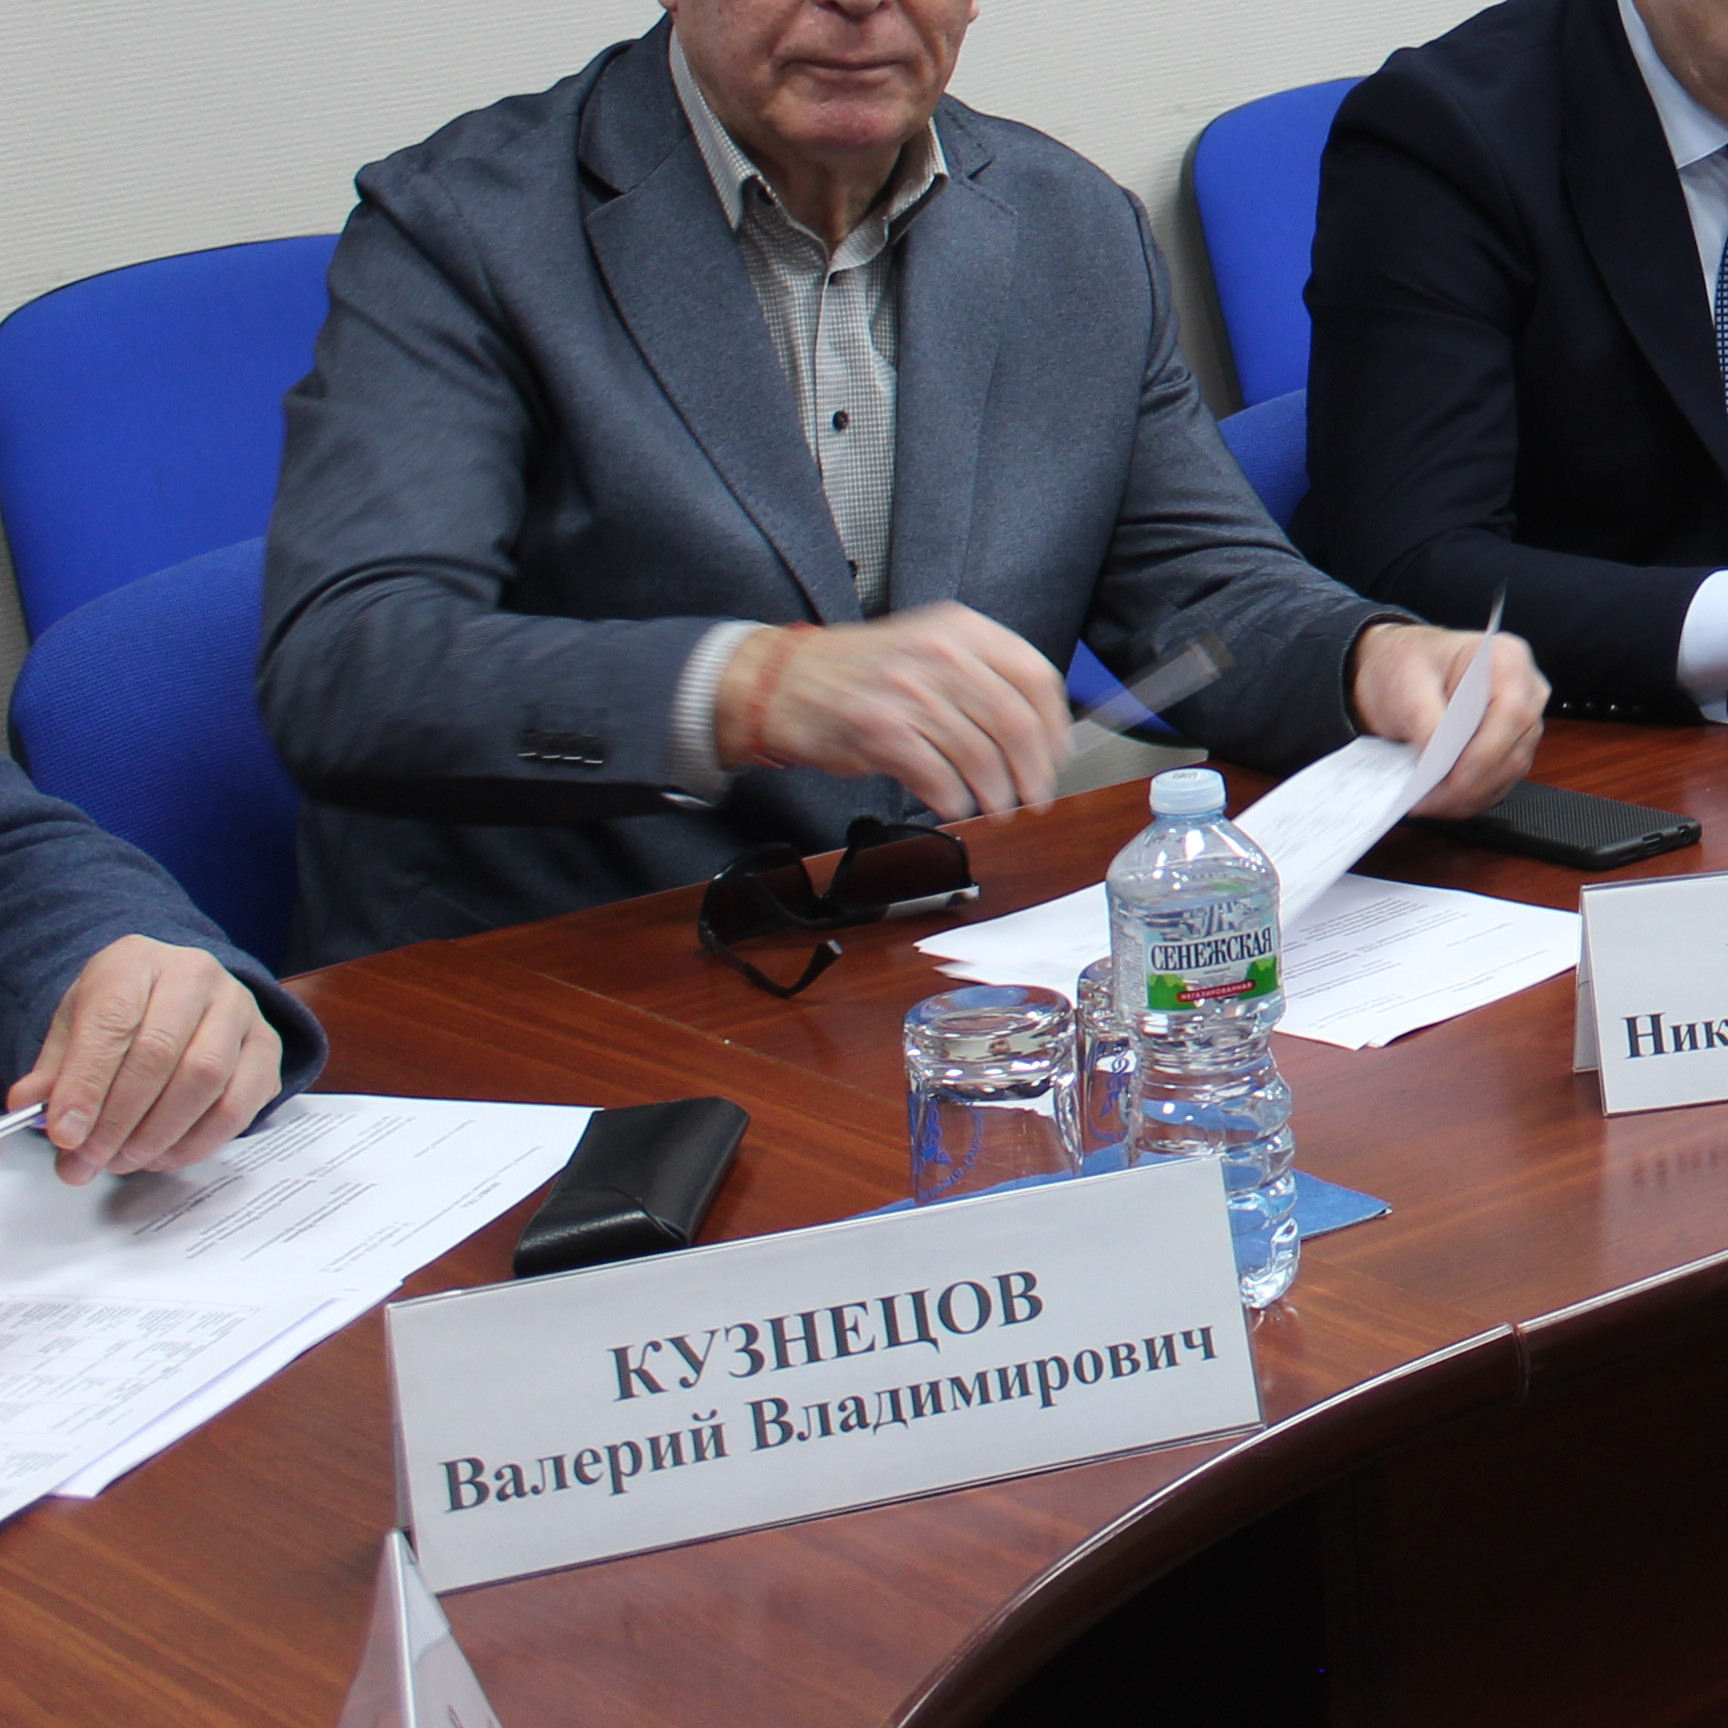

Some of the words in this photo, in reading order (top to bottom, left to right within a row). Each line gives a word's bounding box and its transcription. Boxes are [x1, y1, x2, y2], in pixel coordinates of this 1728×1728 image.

[1150, 925, 1273, 971] СЕНЕЖСКАЯ
[1180, 981, 1252, 1000] НЕГАЗИРОВАННАЯ
[607, 1270, 1045, 1402] КУЗНЕЦОВ
[438, 1411, 731, 1514] Валерий
[746, 1323, 1219, 1454] Владимирович
